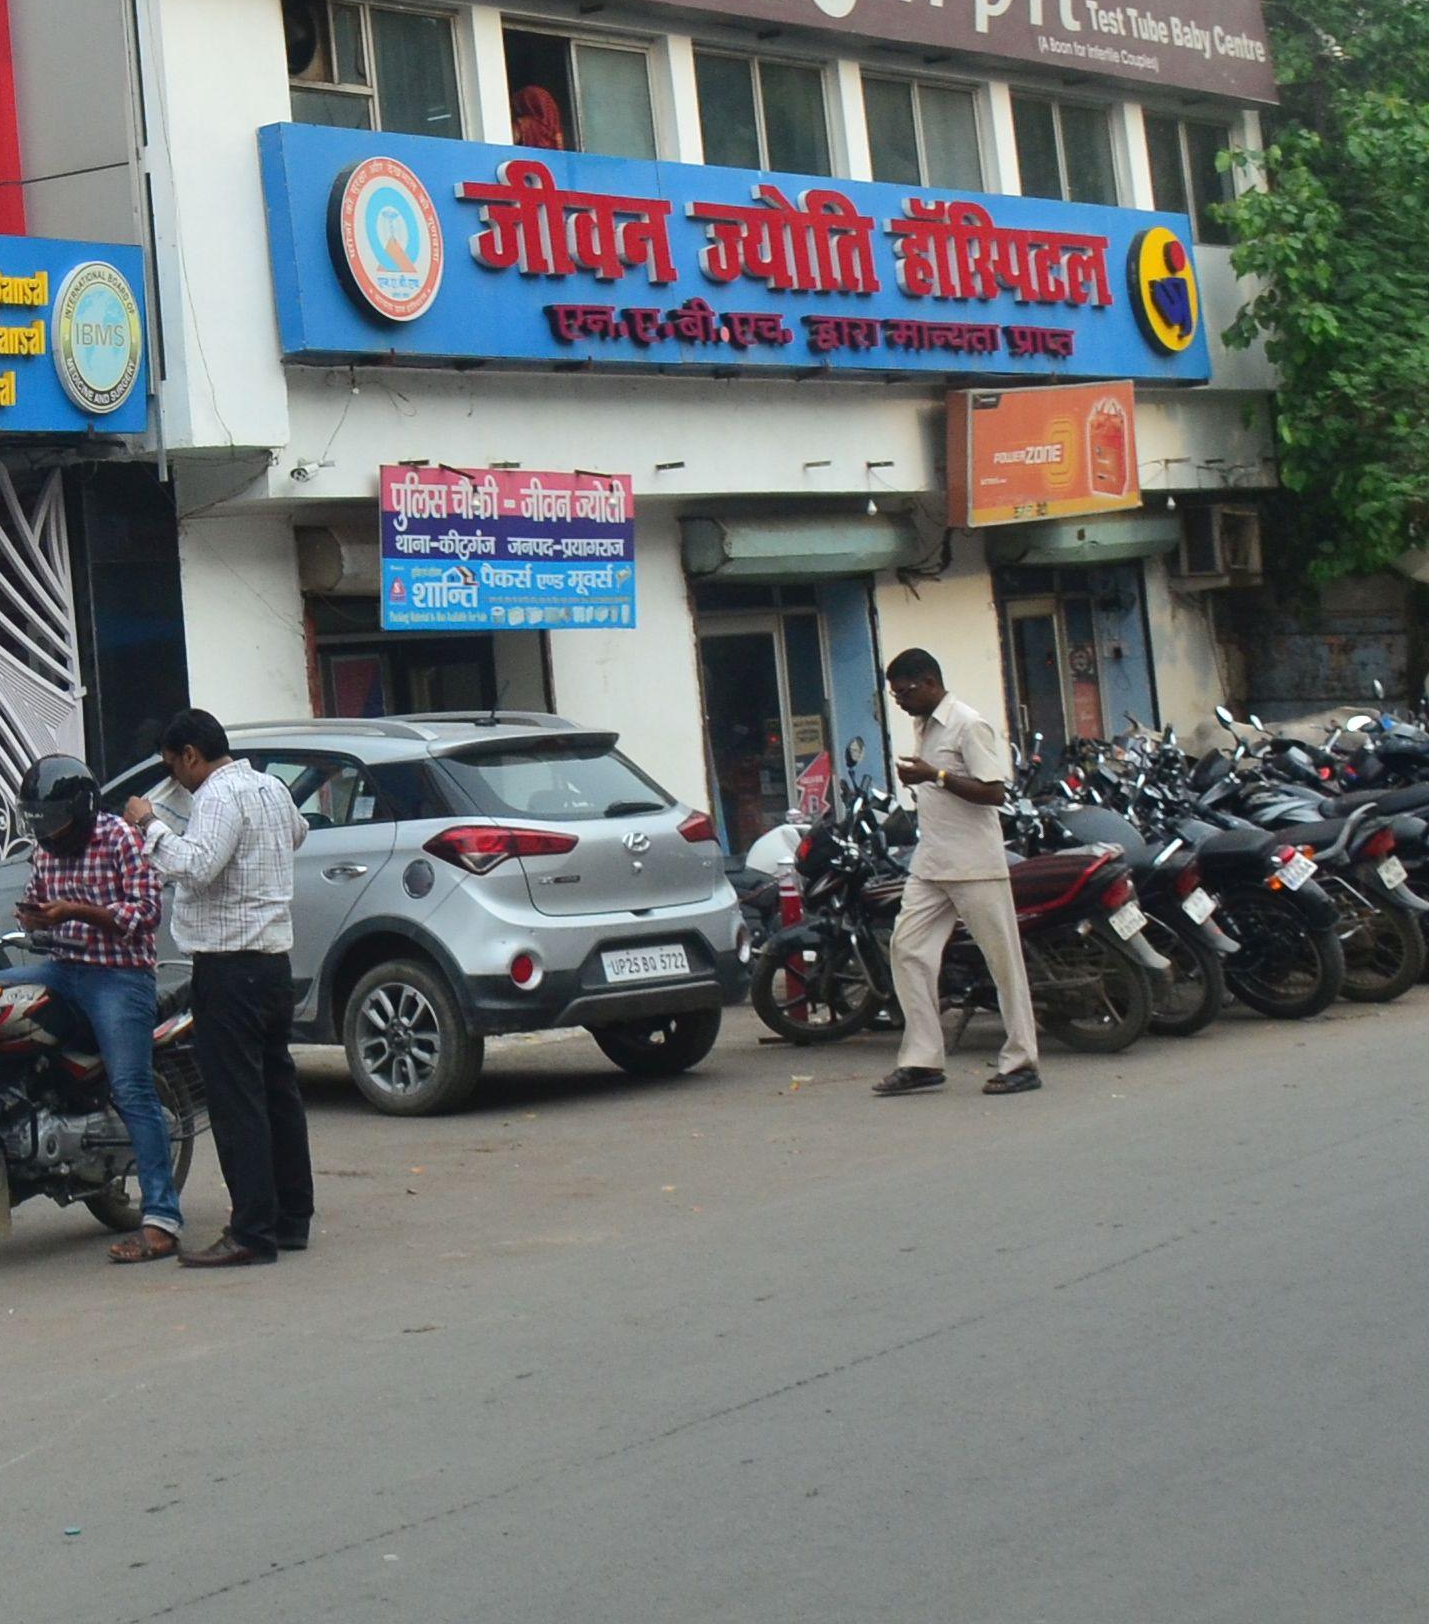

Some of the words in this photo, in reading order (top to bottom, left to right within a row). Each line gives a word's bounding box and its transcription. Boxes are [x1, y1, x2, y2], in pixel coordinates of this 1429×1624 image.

[1085, 0, 1125, 35] Test
[1126, 6, 1169, 44] Tube
[1170, 16, 1212, 60] Baby
[1213, 25, 1265, 63] Centre
[454, 159, 678, 284] जीवन
[685, 183, 880, 295] ज्योति
[883, 197, 1114, 307] हॉस्पिटल
[64, 269, 106, 320] INTERNATIONAL
[106, 272, 131, 304] BOARD
[126, 302, 135, 316] OF
[74, 321, 125, 348] IBMS
[808, 314, 881, 352] द्वारा
[886, 319, 1001, 354] मान्यता
[1007, 325, 1076, 357] प्राप्त
[66, 357, 94, 403] MEDICINE
[92, 388, 110, 404] AND
[108, 361, 136, 399] SURGERY
[391, 472, 447, 531] पुलिस
[452, 475, 498, 520] चौकी
[520, 477, 572, 522] जीवन
[480, 562, 533, 588] पैकर्स
[567, 563, 614, 595] मूवर्स
